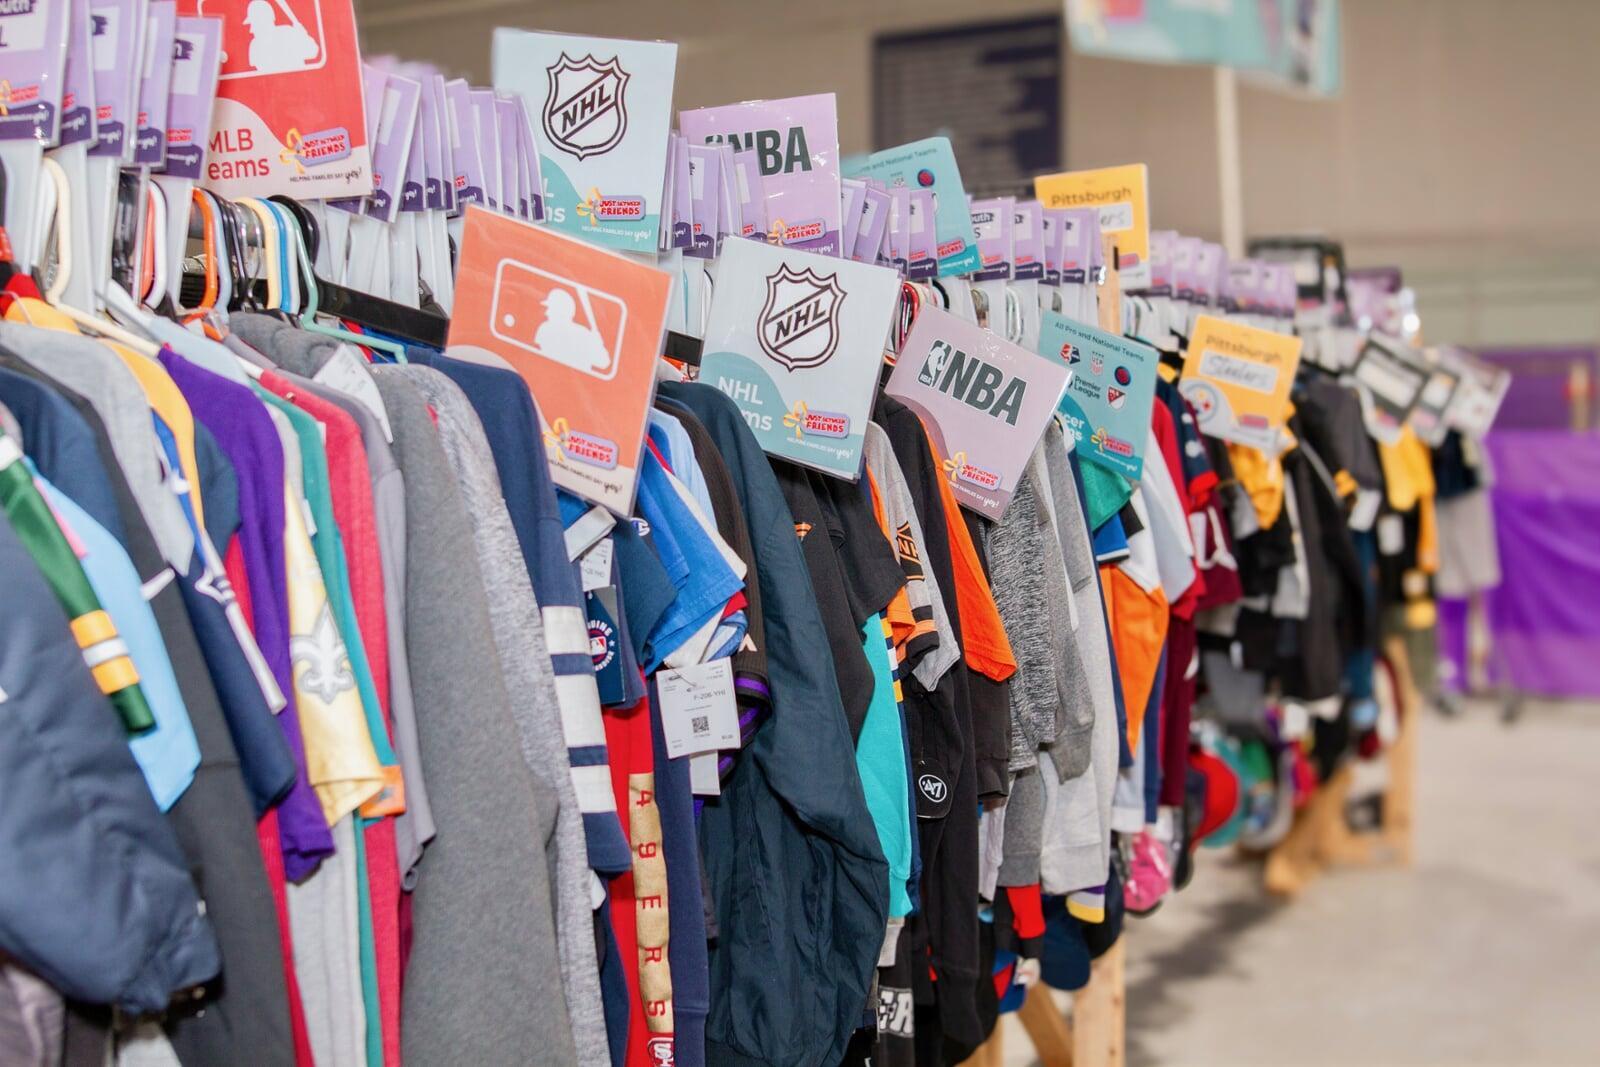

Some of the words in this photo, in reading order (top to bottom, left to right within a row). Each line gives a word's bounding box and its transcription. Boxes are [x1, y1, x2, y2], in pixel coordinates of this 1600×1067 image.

[561, 84, 611, 134] NHL
[305, 143, 345, 159] FRIENDS
[208, 158, 270, 180] eams
[1052, 188, 1132, 206] Pittsburgh
[601, 207, 640, 215] FRIENDS
[786, 228, 821, 240] FRIENDS
[775, 299, 826, 343] NHL
[1092, 336, 1120, 352] National
[1122, 347, 1144, 362] Teams
[718, 376, 763, 405] NHL
[939, 350, 1028, 426] NBA
[1074, 381, 1100, 399] League
[1075, 375, 1101, 391] Premier
[806, 421, 844, 433] FRIENDS
[569, 444, 611, 463] FRIENDS
[962, 471, 995, 486] FRIENDS
[636, 789, 667, 1018] 49ERS
